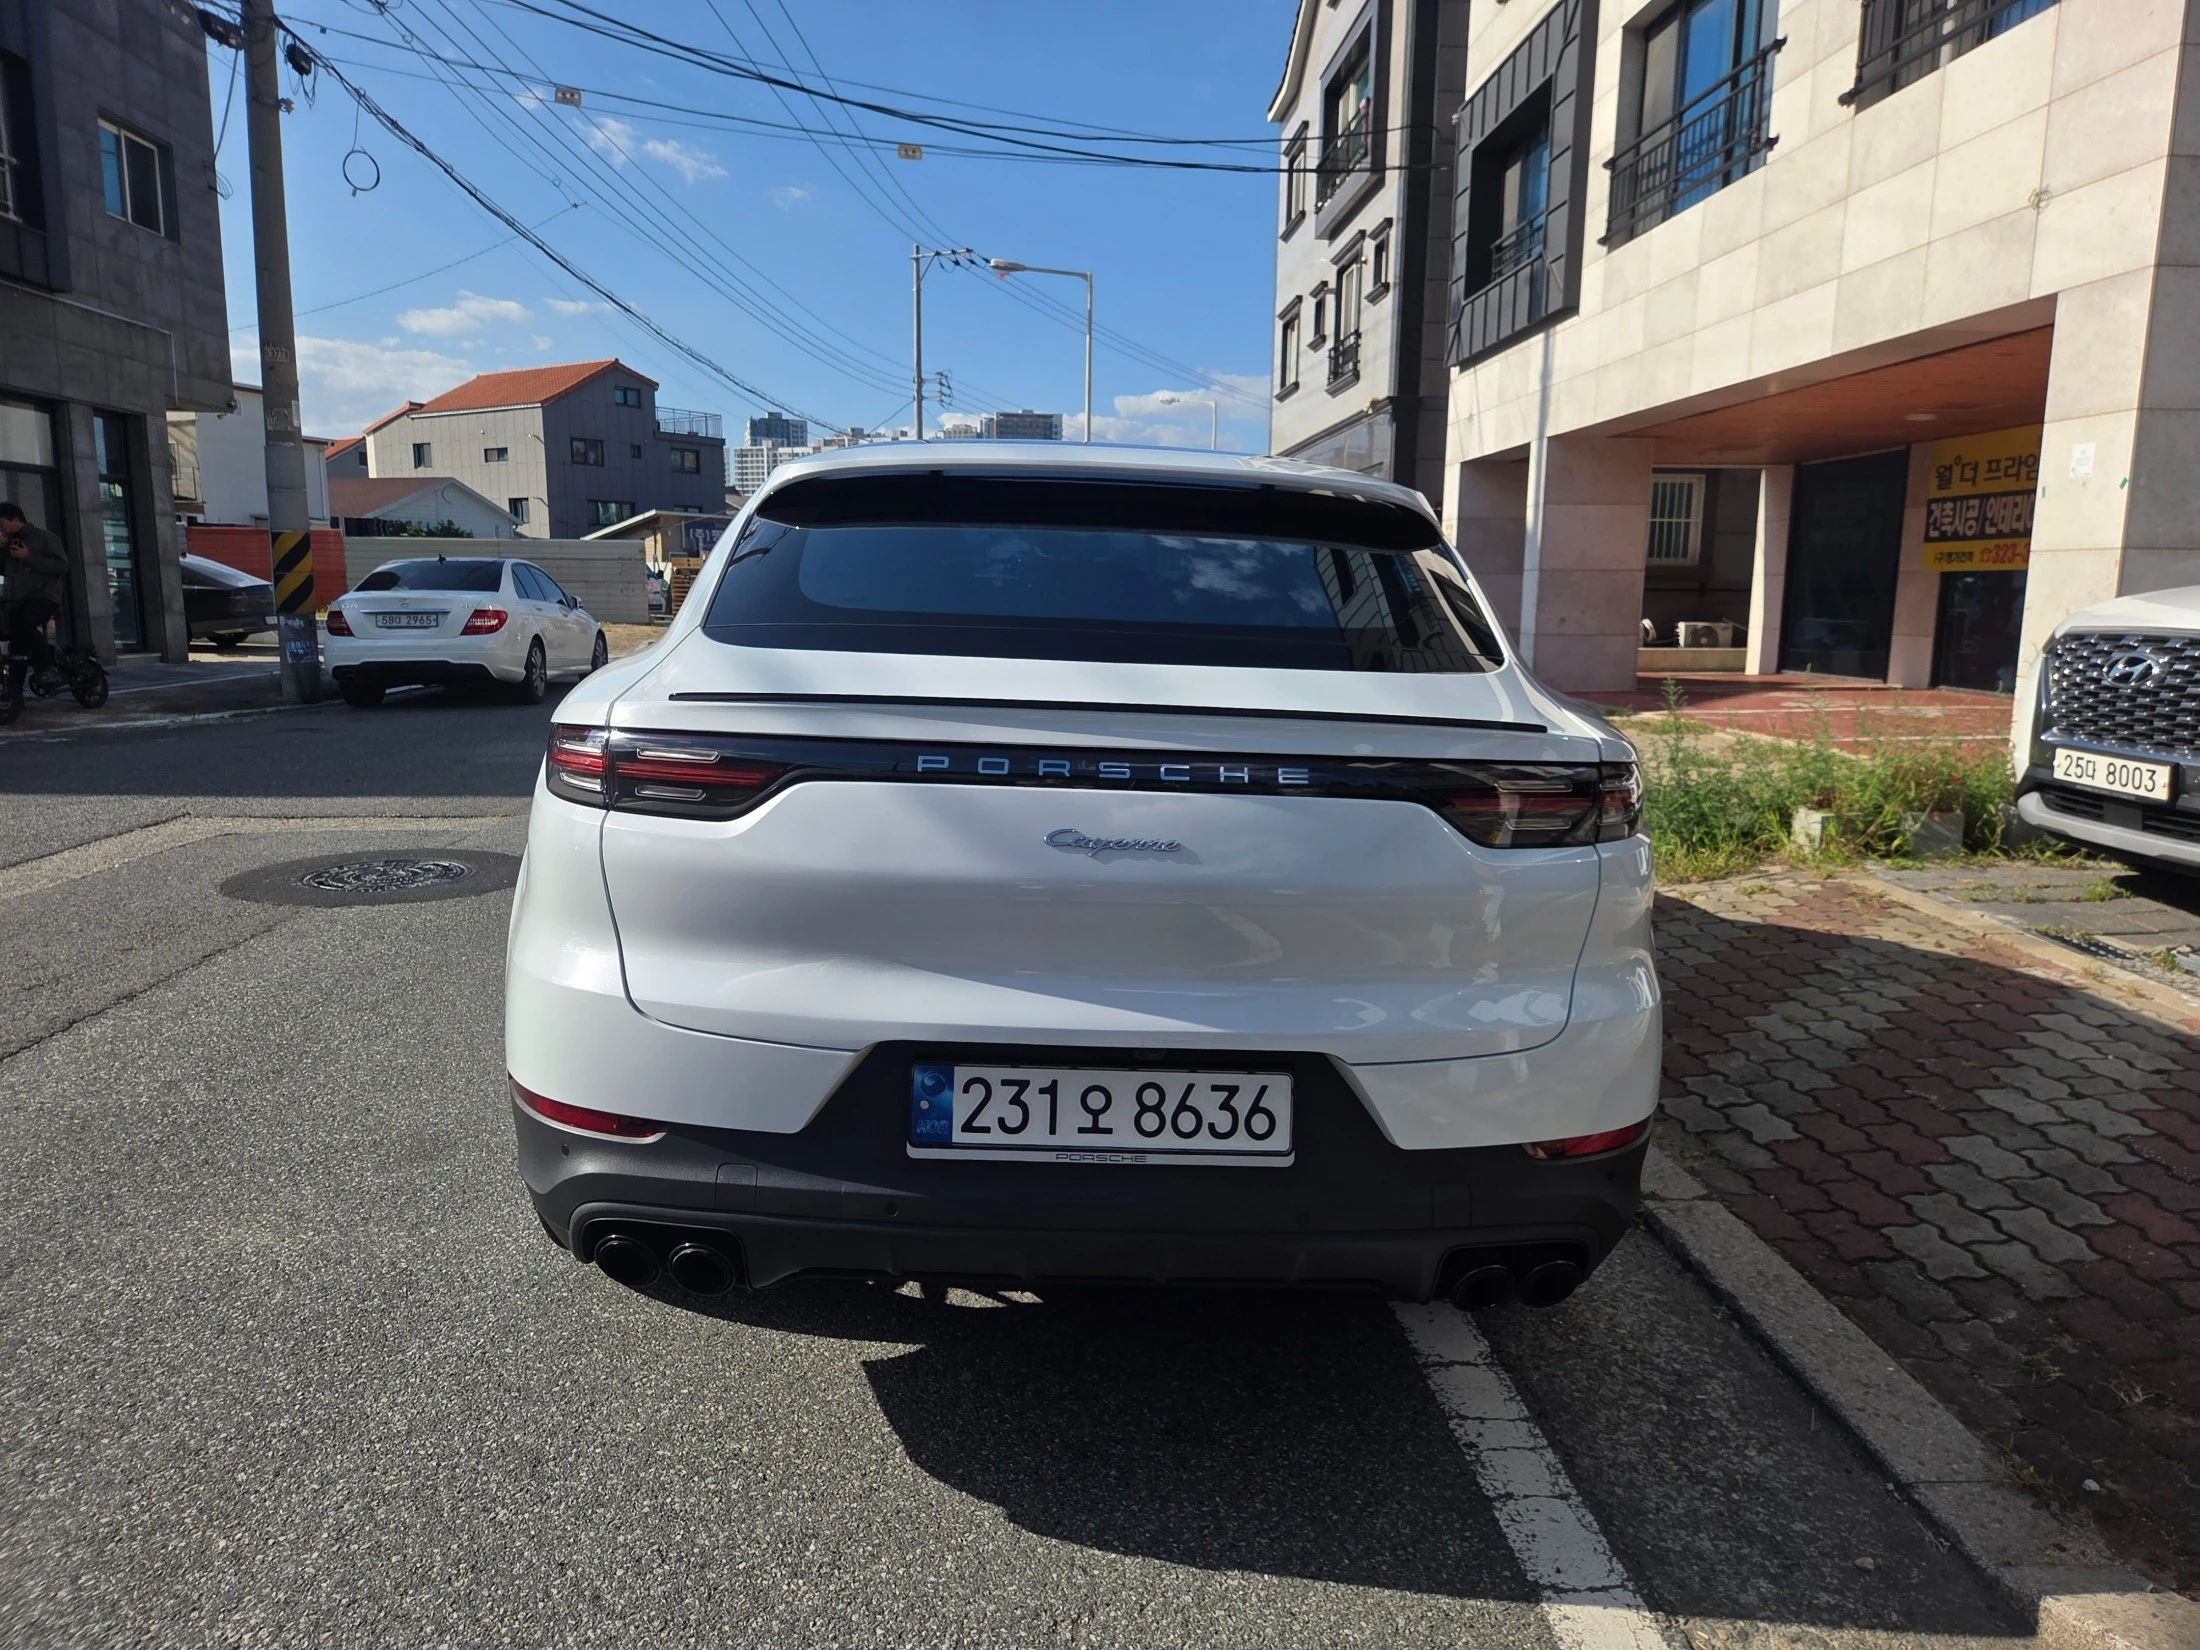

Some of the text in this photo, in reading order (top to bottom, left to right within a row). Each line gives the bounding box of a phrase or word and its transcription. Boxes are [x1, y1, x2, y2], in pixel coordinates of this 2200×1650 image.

[406, 615, 432, 625] 2965
[917, 755, 1310, 785] PORSCHE
[2063, 754, 2097, 782] 25다
[2106, 762, 2157, 793] 8003
[1043, 828, 1181, 857] Cayenne
[916, 1119, 950, 1135] KOR
[1055, 1152, 1148, 1164] PORSCHE
